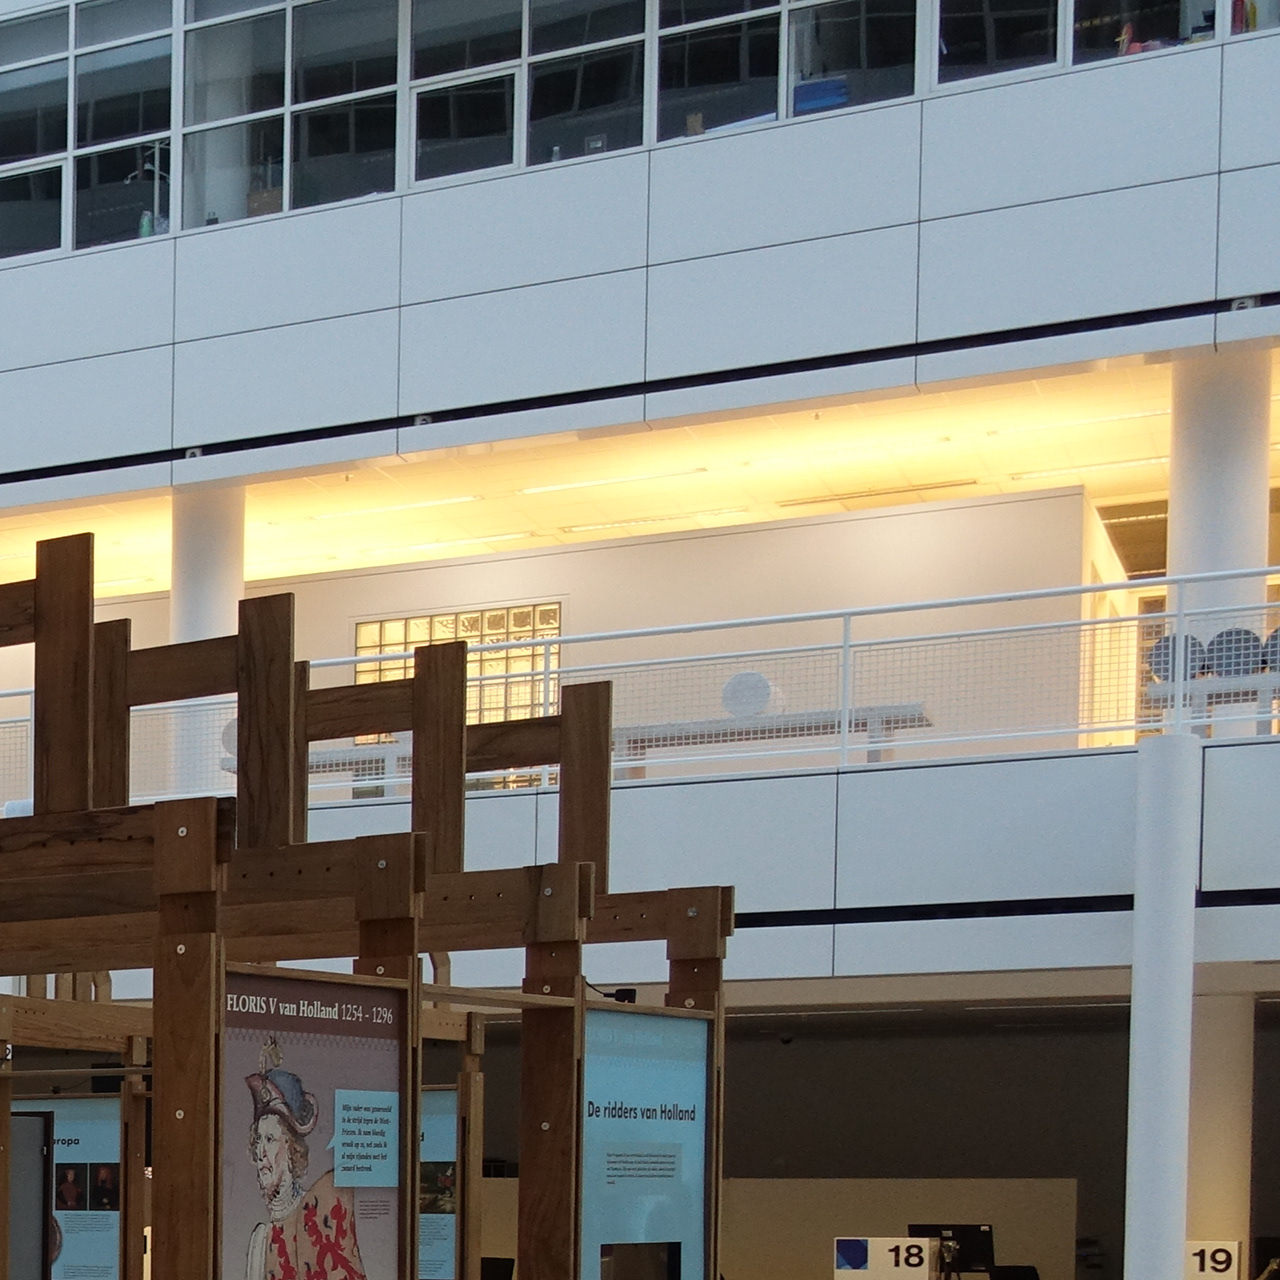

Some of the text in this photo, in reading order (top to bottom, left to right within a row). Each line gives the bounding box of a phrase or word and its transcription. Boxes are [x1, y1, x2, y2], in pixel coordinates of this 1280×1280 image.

[227, 994, 266, 1014] FLORIS
[269, 998, 277, 1014] V
[279, 1002, 296, 1016] van
[299, 1000, 338, 1019] Holland
[342, 1005, 362, 1022] 1254
[372, 1007, 393, 1024] 1296
[588, 1101, 695, 1121] De ridders van Holland
[54, 1138, 79, 1147] ropa
[888, 1245, 924, 1268] 18
[1192, 1248, 1233, 1273] 19
